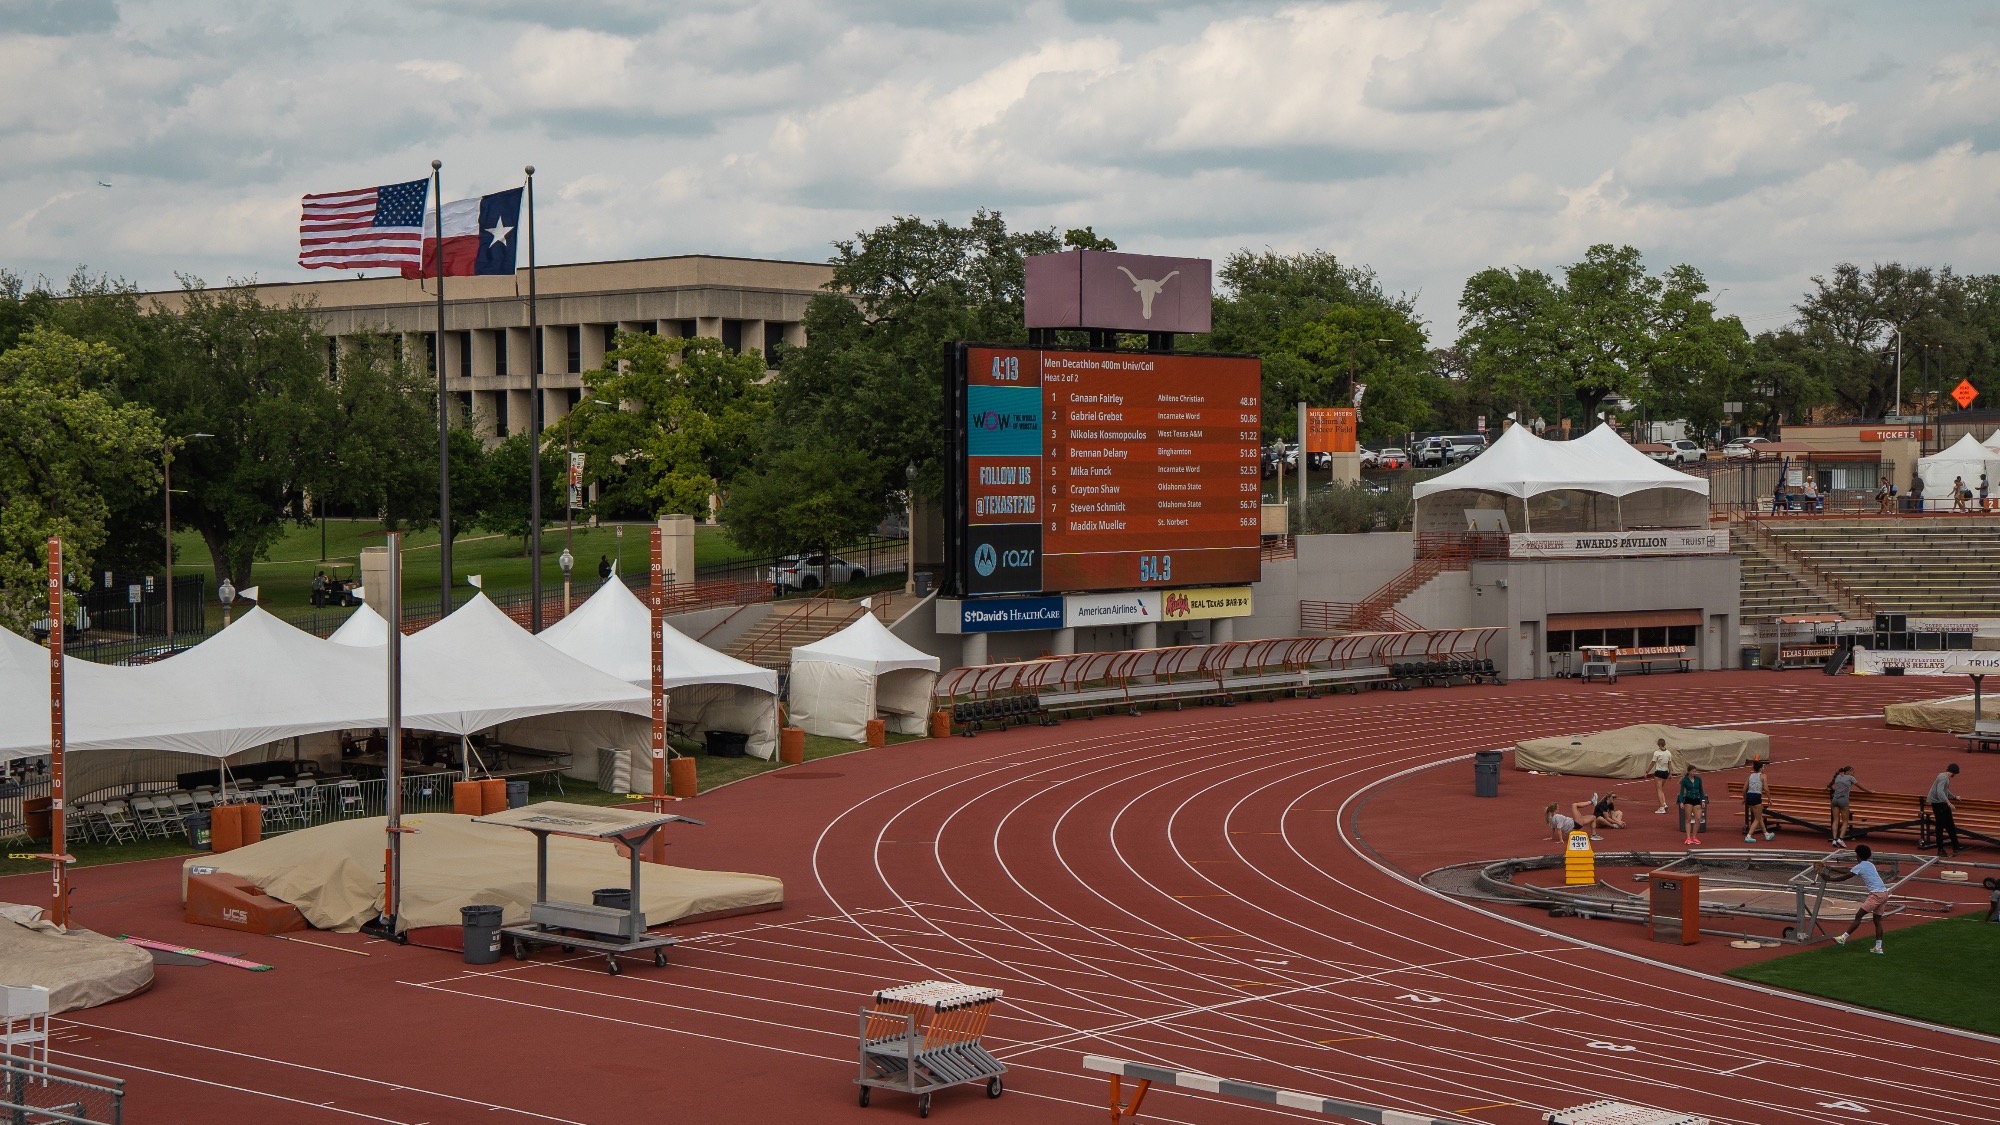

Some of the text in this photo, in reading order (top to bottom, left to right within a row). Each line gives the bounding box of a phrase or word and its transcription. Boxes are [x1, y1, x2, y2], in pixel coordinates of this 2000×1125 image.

[992, 356, 1018, 380] 4:13
[1044, 359, 1154, 371] Men Decathlon 400m Univ/Coll
[1044, 374, 1060, 382] Heat
[1061, 374, 1066, 382] 2
[1067, 374, 1074, 382] of
[1052, 393, 1056, 401] 1
[1070, 393, 1098, 403] Canaan
[1100, 394, 1123, 405] Fairley
[1180, 394, 1204, 403] Christian
[1240, 397, 1257, 405] 48.81
[1052, 412, 1056, 420] 2
[1070, 411, 1097, 421] Gabriel
[1098, 412, 1122, 421] Grebet
[1240, 414, 1257, 423] 50.86
[1052, 430, 1056, 438] 3
[1070, 430, 1098, 439] Nikolas
[1099, 430, 1146, 441] Kosmopoulos
[1240, 432, 1257, 440] 51.22
[1052, 448, 1257, 459] 4 Brennan Delany Binghamton 51.83
[980, 467, 1030, 485] FOLLOW US
[1052, 467, 1056, 475] 5
[1070, 466, 1088, 475] Mika
[1090, 466, 1111, 475] Funck
[1240, 466, 1257, 474] 52.53
[1052, 485, 1056, 494] 6
[1070, 485, 1099, 496] Crayton
[1100, 485, 1120, 494] Shaw
[1240, 483, 1257, 492] 53.04
[976, 496, 1035, 516] @TEXASTFXC
[1052, 504, 1056, 512] 7
[1070, 504, 1095, 513] Steven
[1096, 502, 1125, 512] Schmidt
[1240, 501, 1257, 509] 56.76
[1988, 501, 1994, 509] 2
[1052, 522, 1056, 531] 8
[1070, 522, 1097, 530] Maddix
[1099, 520, 1126, 529] Mueller
[1240, 518, 1257, 526] 56.88
[1576, 538, 1667, 549] AWARDS PAVILION
[1002, 550, 1034, 567] razr
[1140, 555, 1171, 582] 54.3
[1191, 600, 1205, 608] REAL
[1206, 599, 1224, 608] TEXAS
[1078, 604, 1137, 616] American Airlines
[51, 619, 59, 627] 18
[1633, 646, 1686, 655] LONGHORNS
[1782, 650, 1801, 658] TEXAS
[52, 659, 59, 668] 16
[52, 699, 60, 708] 14
[52, 739, 60, 748] 12
[53, 779, 60, 787] 10
[223, 908, 248, 920] UCS
